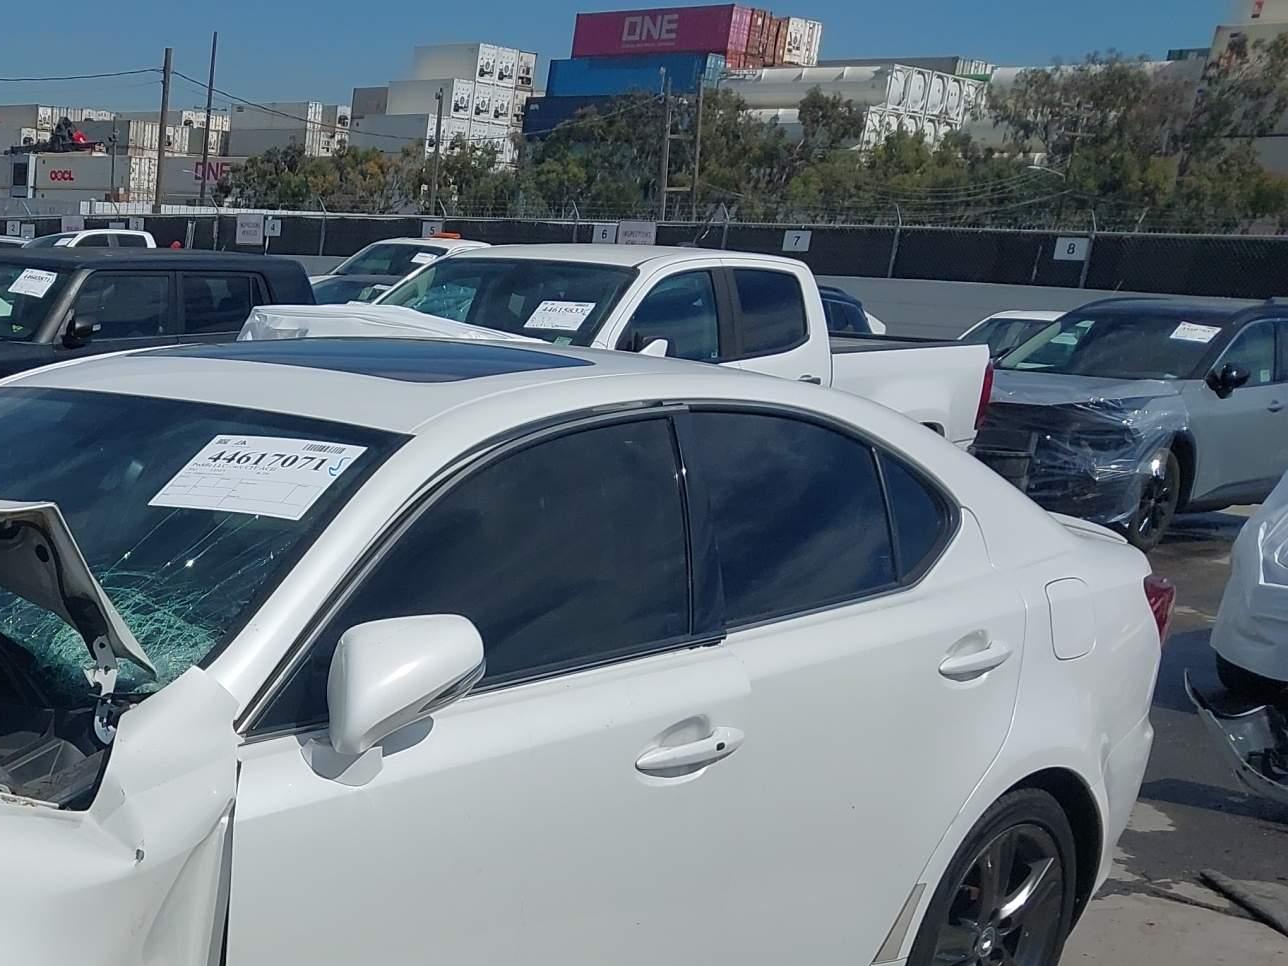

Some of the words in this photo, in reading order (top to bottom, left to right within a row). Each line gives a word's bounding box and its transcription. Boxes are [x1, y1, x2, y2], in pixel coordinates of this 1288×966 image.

[621, 14, 679, 41] ONE
[49, 170, 74, 181] OOCL
[601, 229, 608, 239] 6
[794, 236, 801, 246] 7
[1067, 243, 1076, 255] 8
[208, 450, 328, 471] 44617071
